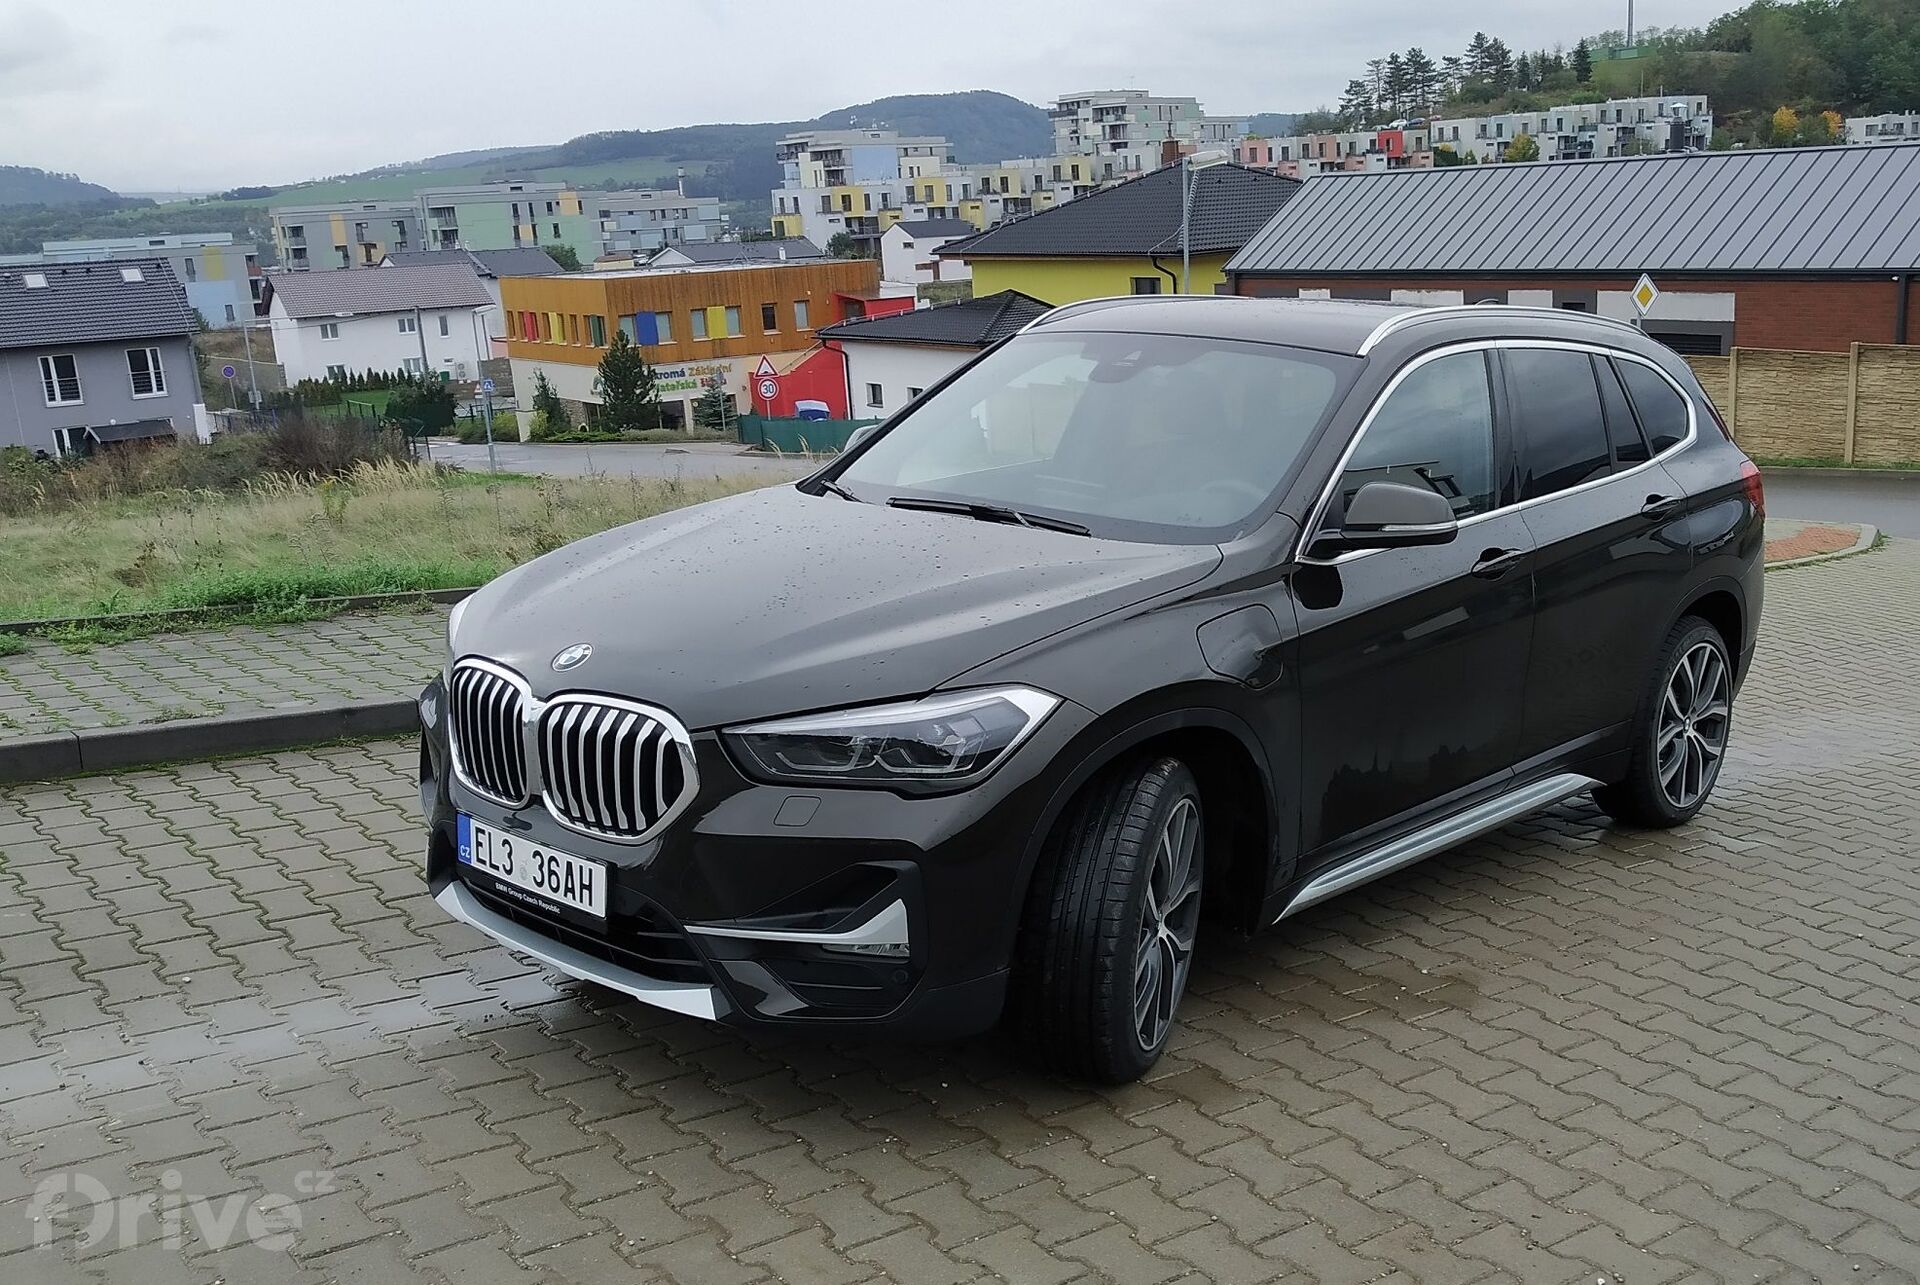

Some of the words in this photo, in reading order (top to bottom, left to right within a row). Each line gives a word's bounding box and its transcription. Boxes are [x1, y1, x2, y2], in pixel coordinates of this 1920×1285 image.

[762, 383, 775, 394] 30
[460, 844, 471, 859] CZ
[474, 825, 514, 876] EL3
[531, 849, 593, 908] 36AH
